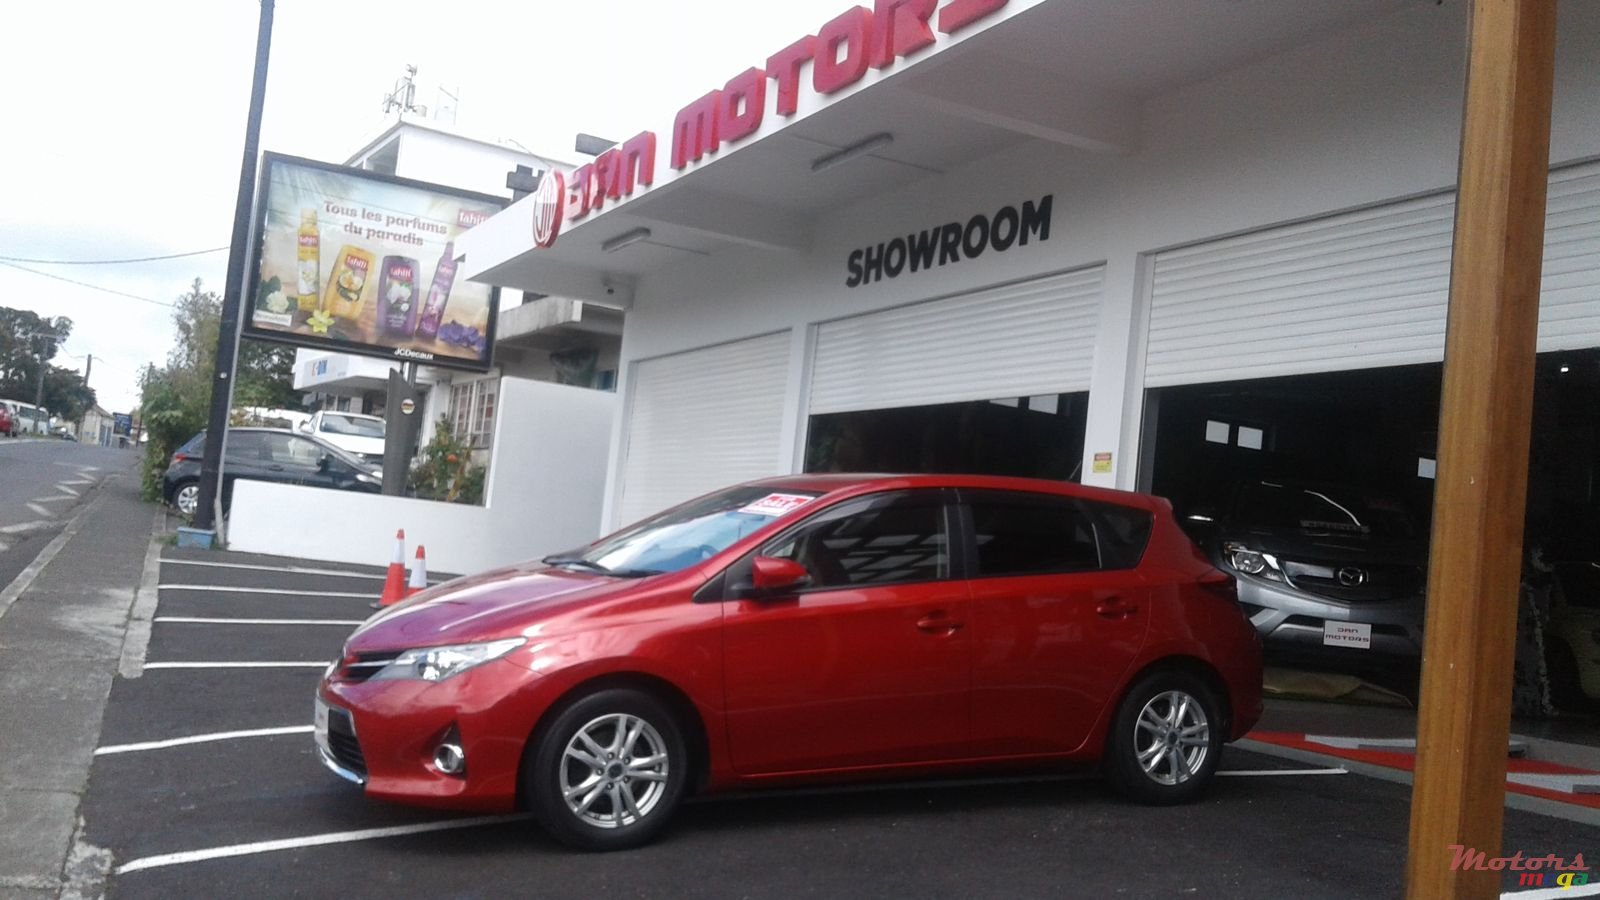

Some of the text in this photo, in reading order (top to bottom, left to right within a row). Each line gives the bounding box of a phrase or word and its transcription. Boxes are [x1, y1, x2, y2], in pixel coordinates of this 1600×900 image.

[324, 200, 448, 235] Tous les parfums
[343, 222, 424, 246] du paradis
[845, 194, 1054, 288] SHOWROOM
[394, 347, 434, 360] JCDecaux
